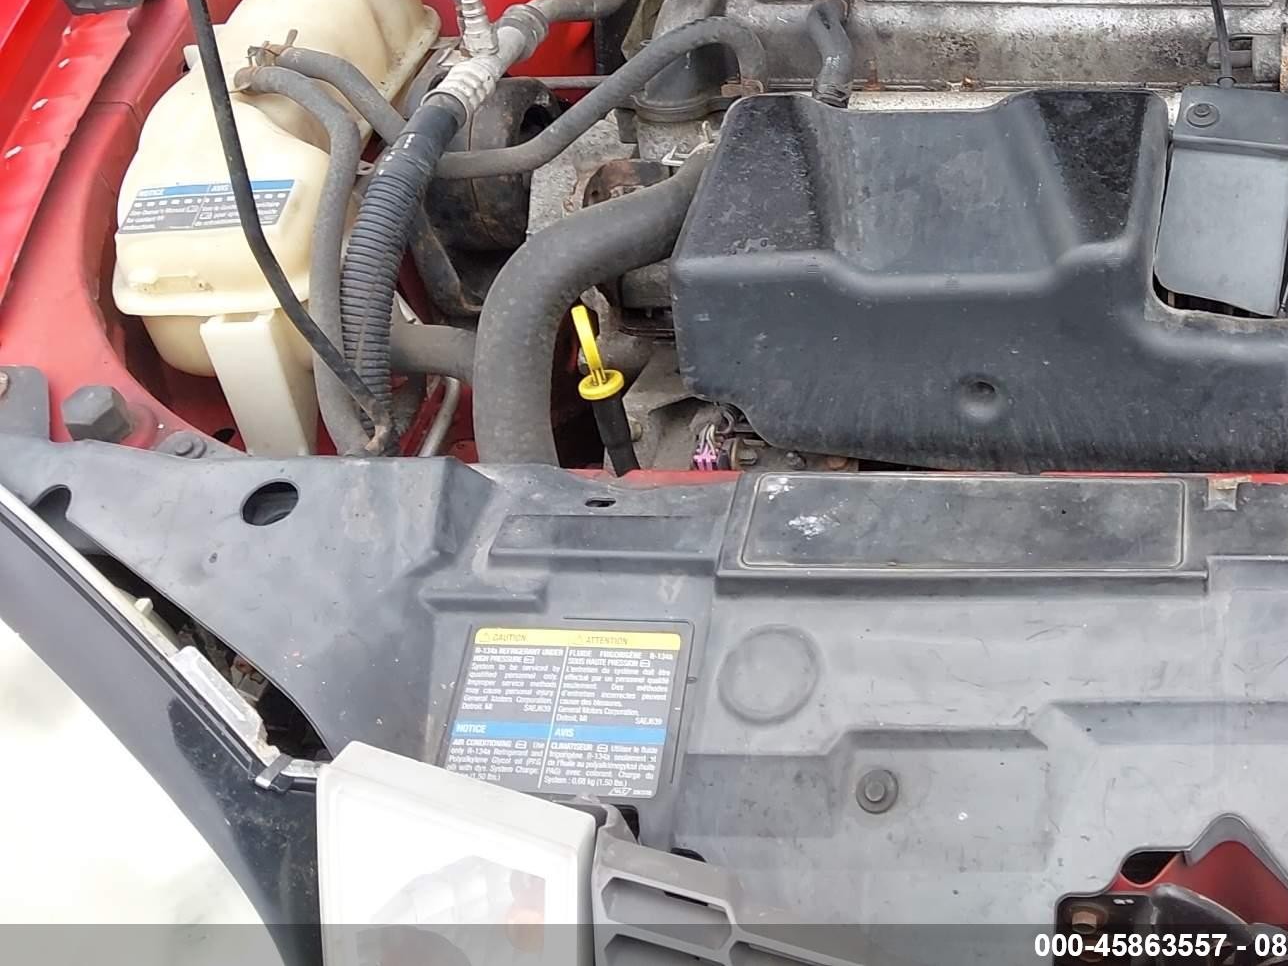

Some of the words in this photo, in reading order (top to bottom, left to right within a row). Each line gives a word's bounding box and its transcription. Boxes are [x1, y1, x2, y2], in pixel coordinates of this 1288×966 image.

[492, 634, 528, 642] CAUTION
[586, 636, 628, 645] ATTENTION
[456, 724, 487, 733] NOTICE
[554, 728, 574, 737] AVIS
